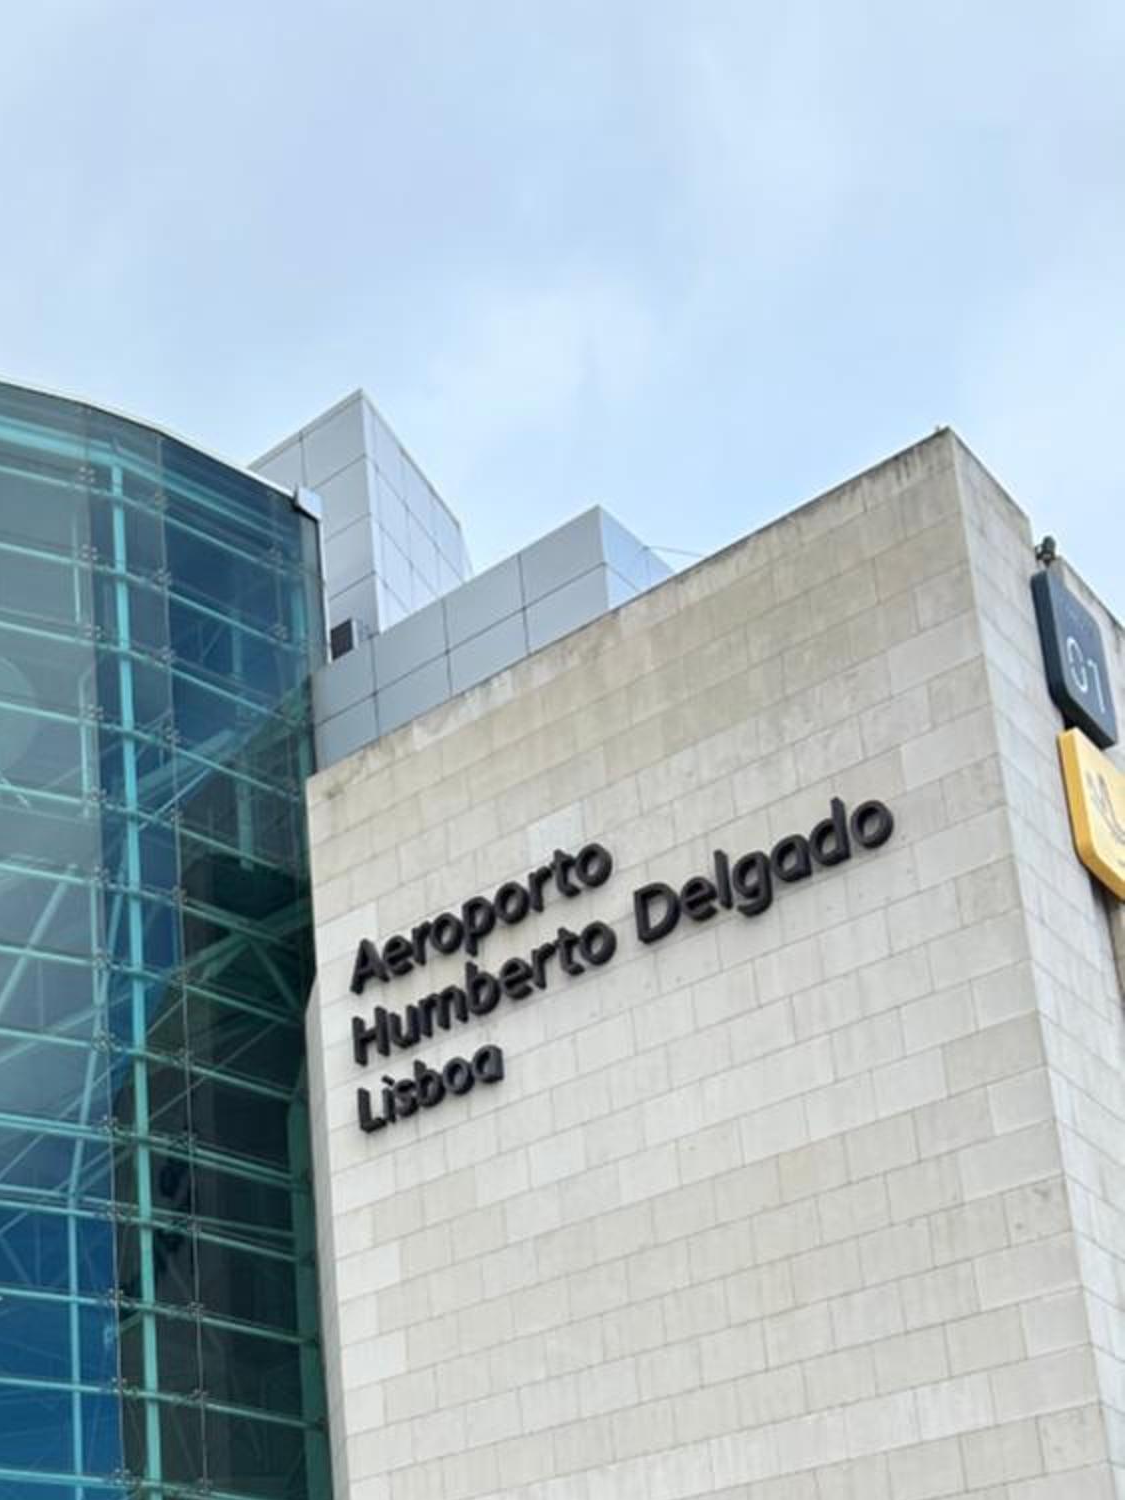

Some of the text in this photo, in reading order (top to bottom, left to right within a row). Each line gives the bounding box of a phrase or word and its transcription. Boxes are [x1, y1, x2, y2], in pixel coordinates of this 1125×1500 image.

[351, 841, 613, 995] Aeroporto
[351, 796, 895, 1067] Humberto Delgado
[357, 1043, 505, 1134] Lisboa
